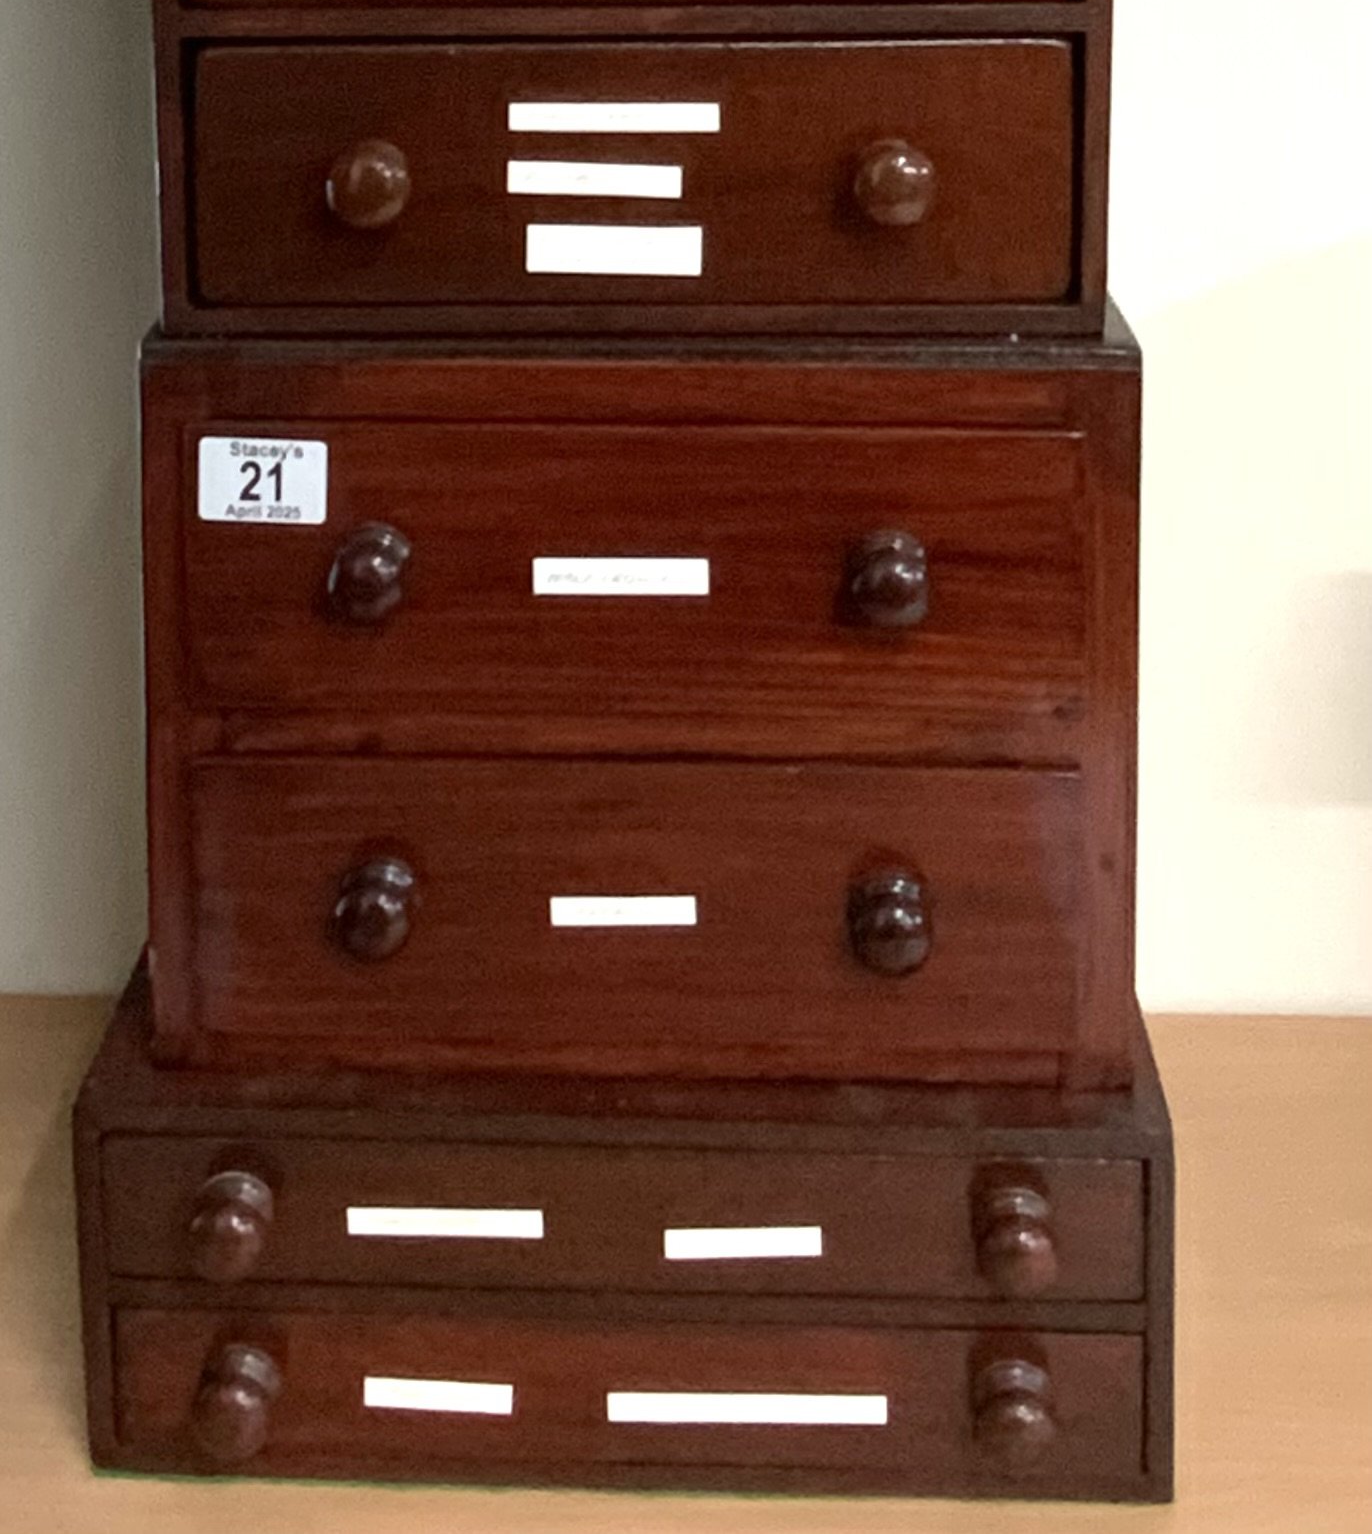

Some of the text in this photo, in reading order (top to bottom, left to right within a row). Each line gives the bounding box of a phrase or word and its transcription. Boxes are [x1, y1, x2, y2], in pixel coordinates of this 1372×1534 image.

[229, 441, 304, 460] Stacey's
[239, 460, 282, 502] 21
[225, 503, 262, 520] April
